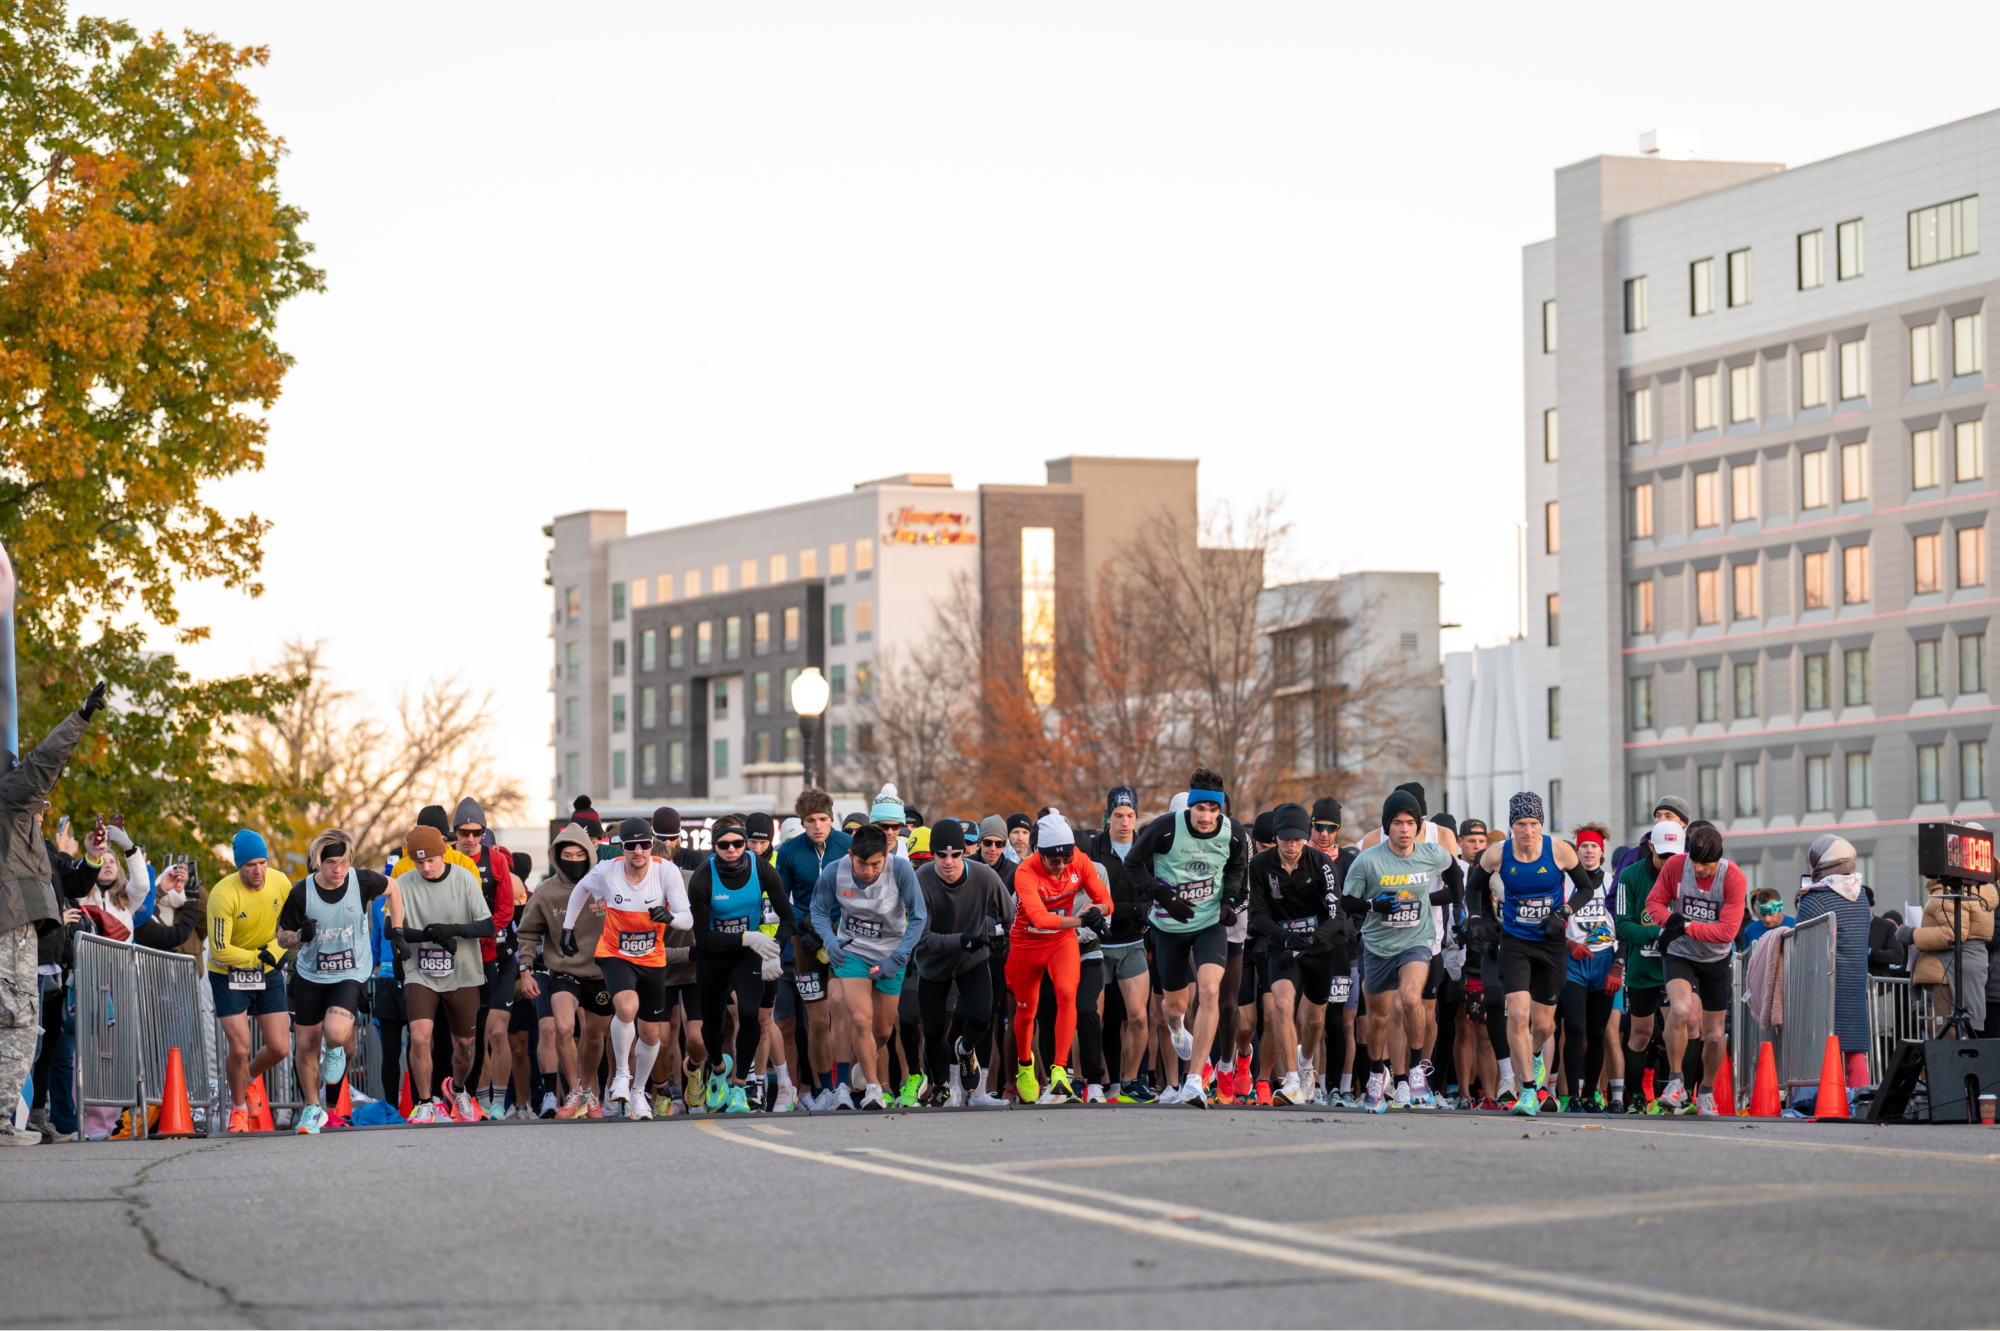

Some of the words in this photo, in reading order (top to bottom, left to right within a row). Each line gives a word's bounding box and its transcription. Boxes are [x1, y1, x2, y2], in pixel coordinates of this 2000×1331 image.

[1322, 863, 1335, 890] FLEET
[1379, 872, 1430, 886] RUNATL
[1179, 886, 1212, 900] 0409
[1519, 905, 1551, 918] 0210
[1577, 905, 1604, 917] 0344
[1685, 904, 1716, 920] 0298
[717, 924, 747, 934] 1468
[848, 924, 879, 938] 0482
[621, 939, 654, 951] 0605
[320, 959, 353, 970] 0916
[420, 958, 452, 970] 0858
[231, 970, 262, 983] 1030
